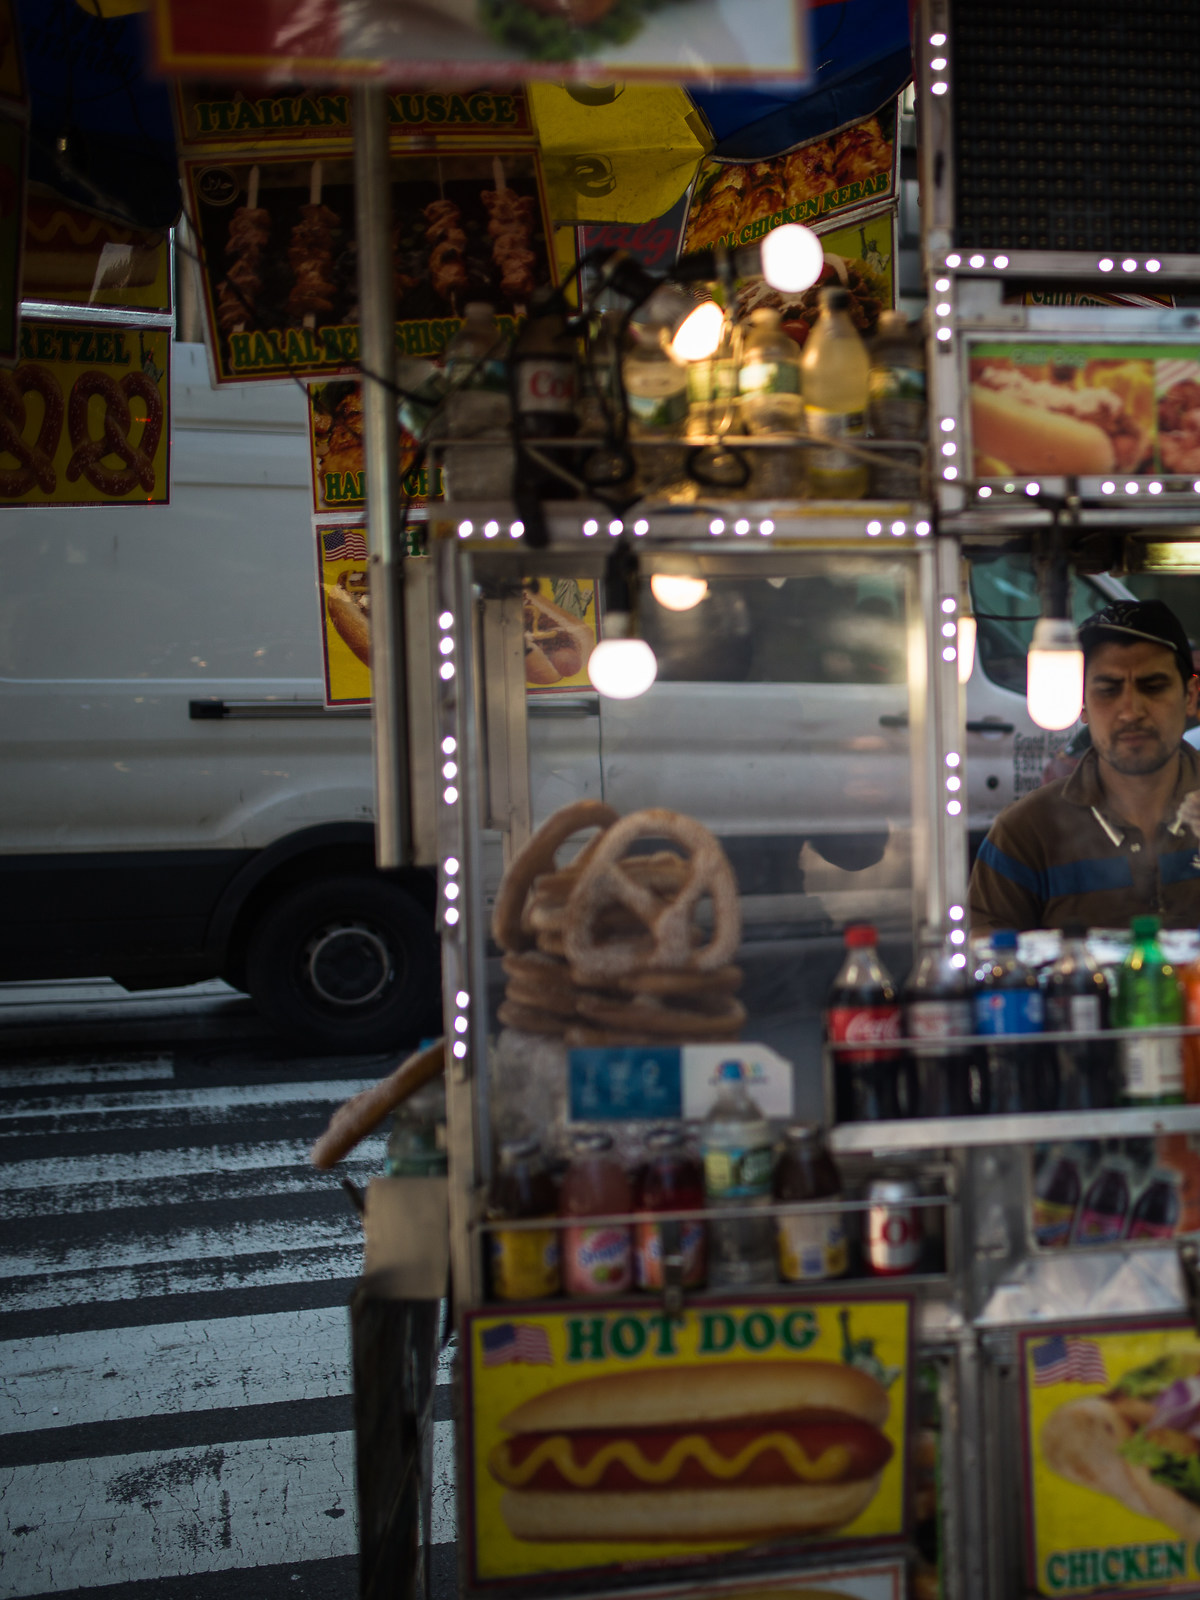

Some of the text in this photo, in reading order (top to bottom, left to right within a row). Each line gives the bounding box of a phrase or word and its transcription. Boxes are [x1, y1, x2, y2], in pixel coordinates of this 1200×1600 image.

[199, 95, 517, 132] ITALIAN AUSAGE
[739, 198, 821, 244] CHICKEN
[823, 172, 889, 213] KEBAB
[20, 326, 130, 364] RETZEL
[230, 328, 321, 369] HALAL
[567, 1311, 818, 1361] HOT DOG
[1046, 1541, 1187, 1589] CHICKEN
